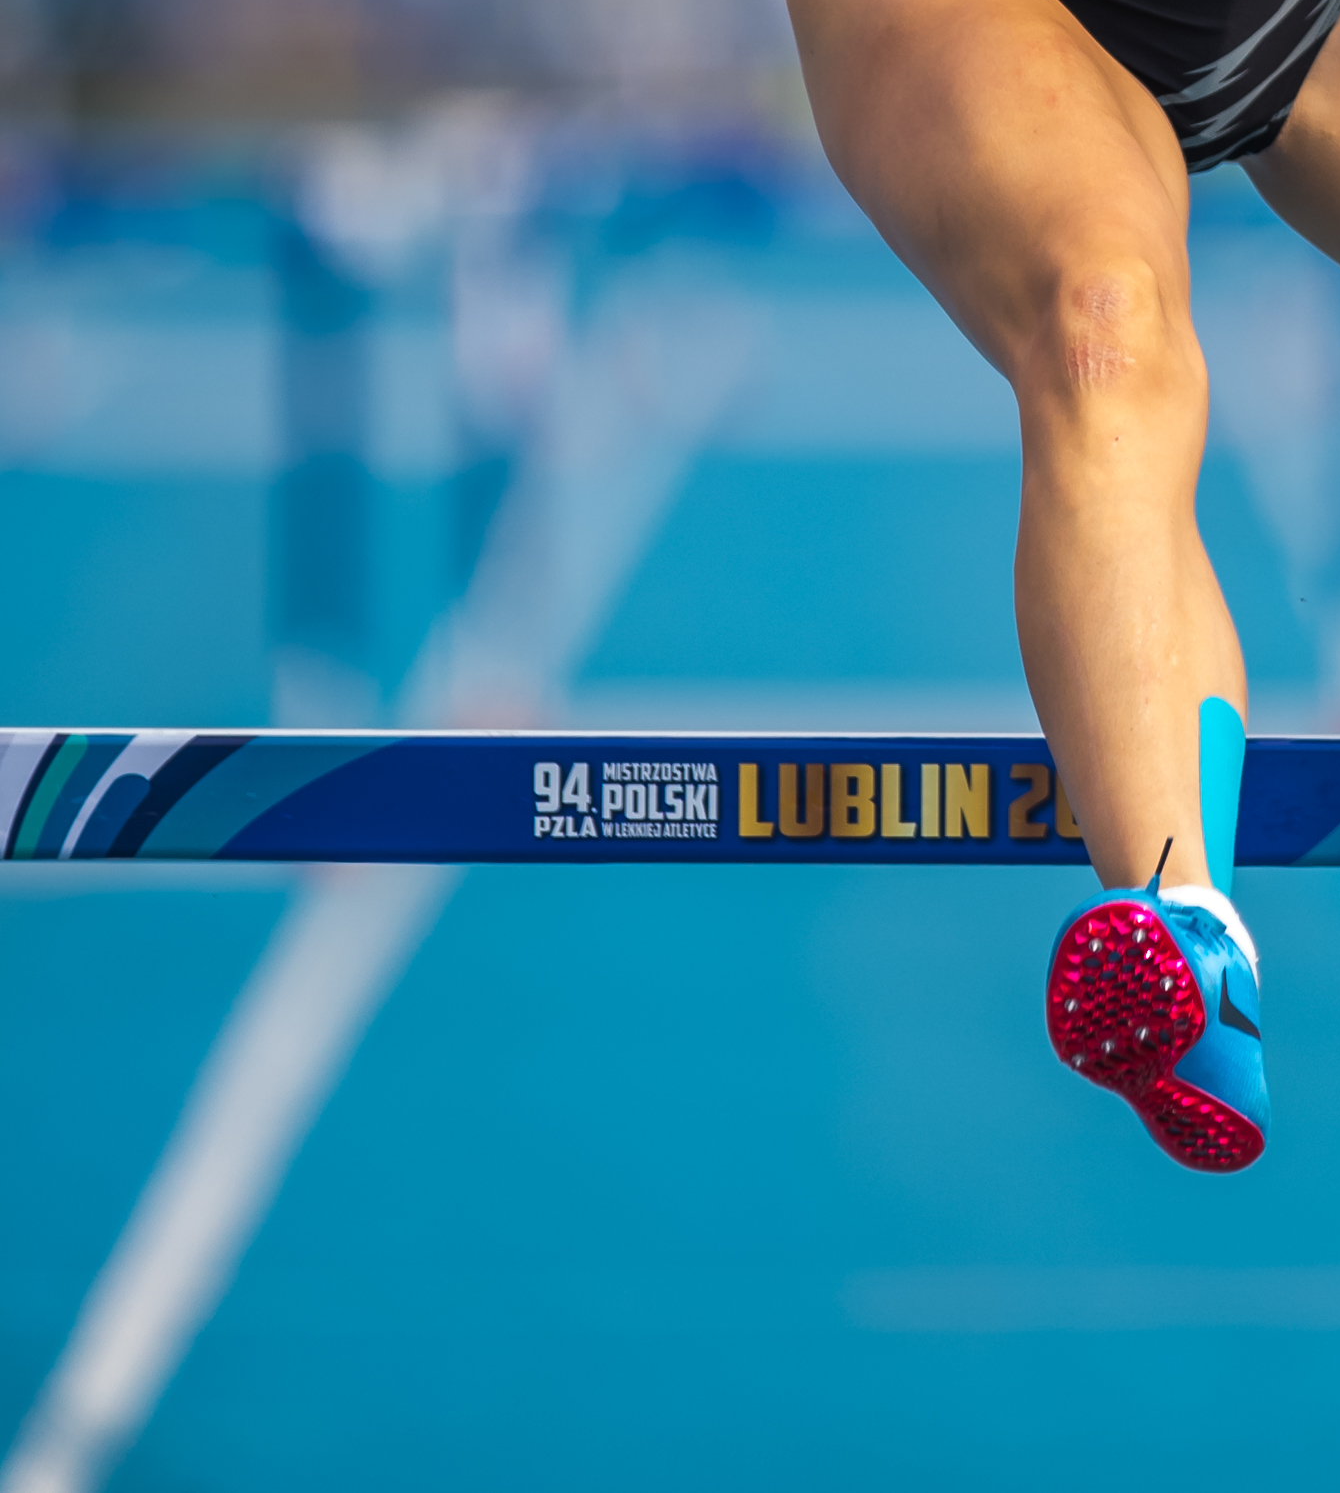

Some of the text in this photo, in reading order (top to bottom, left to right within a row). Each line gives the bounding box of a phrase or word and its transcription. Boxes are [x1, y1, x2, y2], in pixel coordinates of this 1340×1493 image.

[533, 761, 599, 814] 94.
[602, 762, 719, 782] MISTRZOSTWA
[601, 783, 719, 822] POLSKI
[738, 763, 990, 838] LUBLIN
[533, 815, 599, 839] PZLA
[602, 821, 718, 839] W LEKKIEJ ATLETYCE
